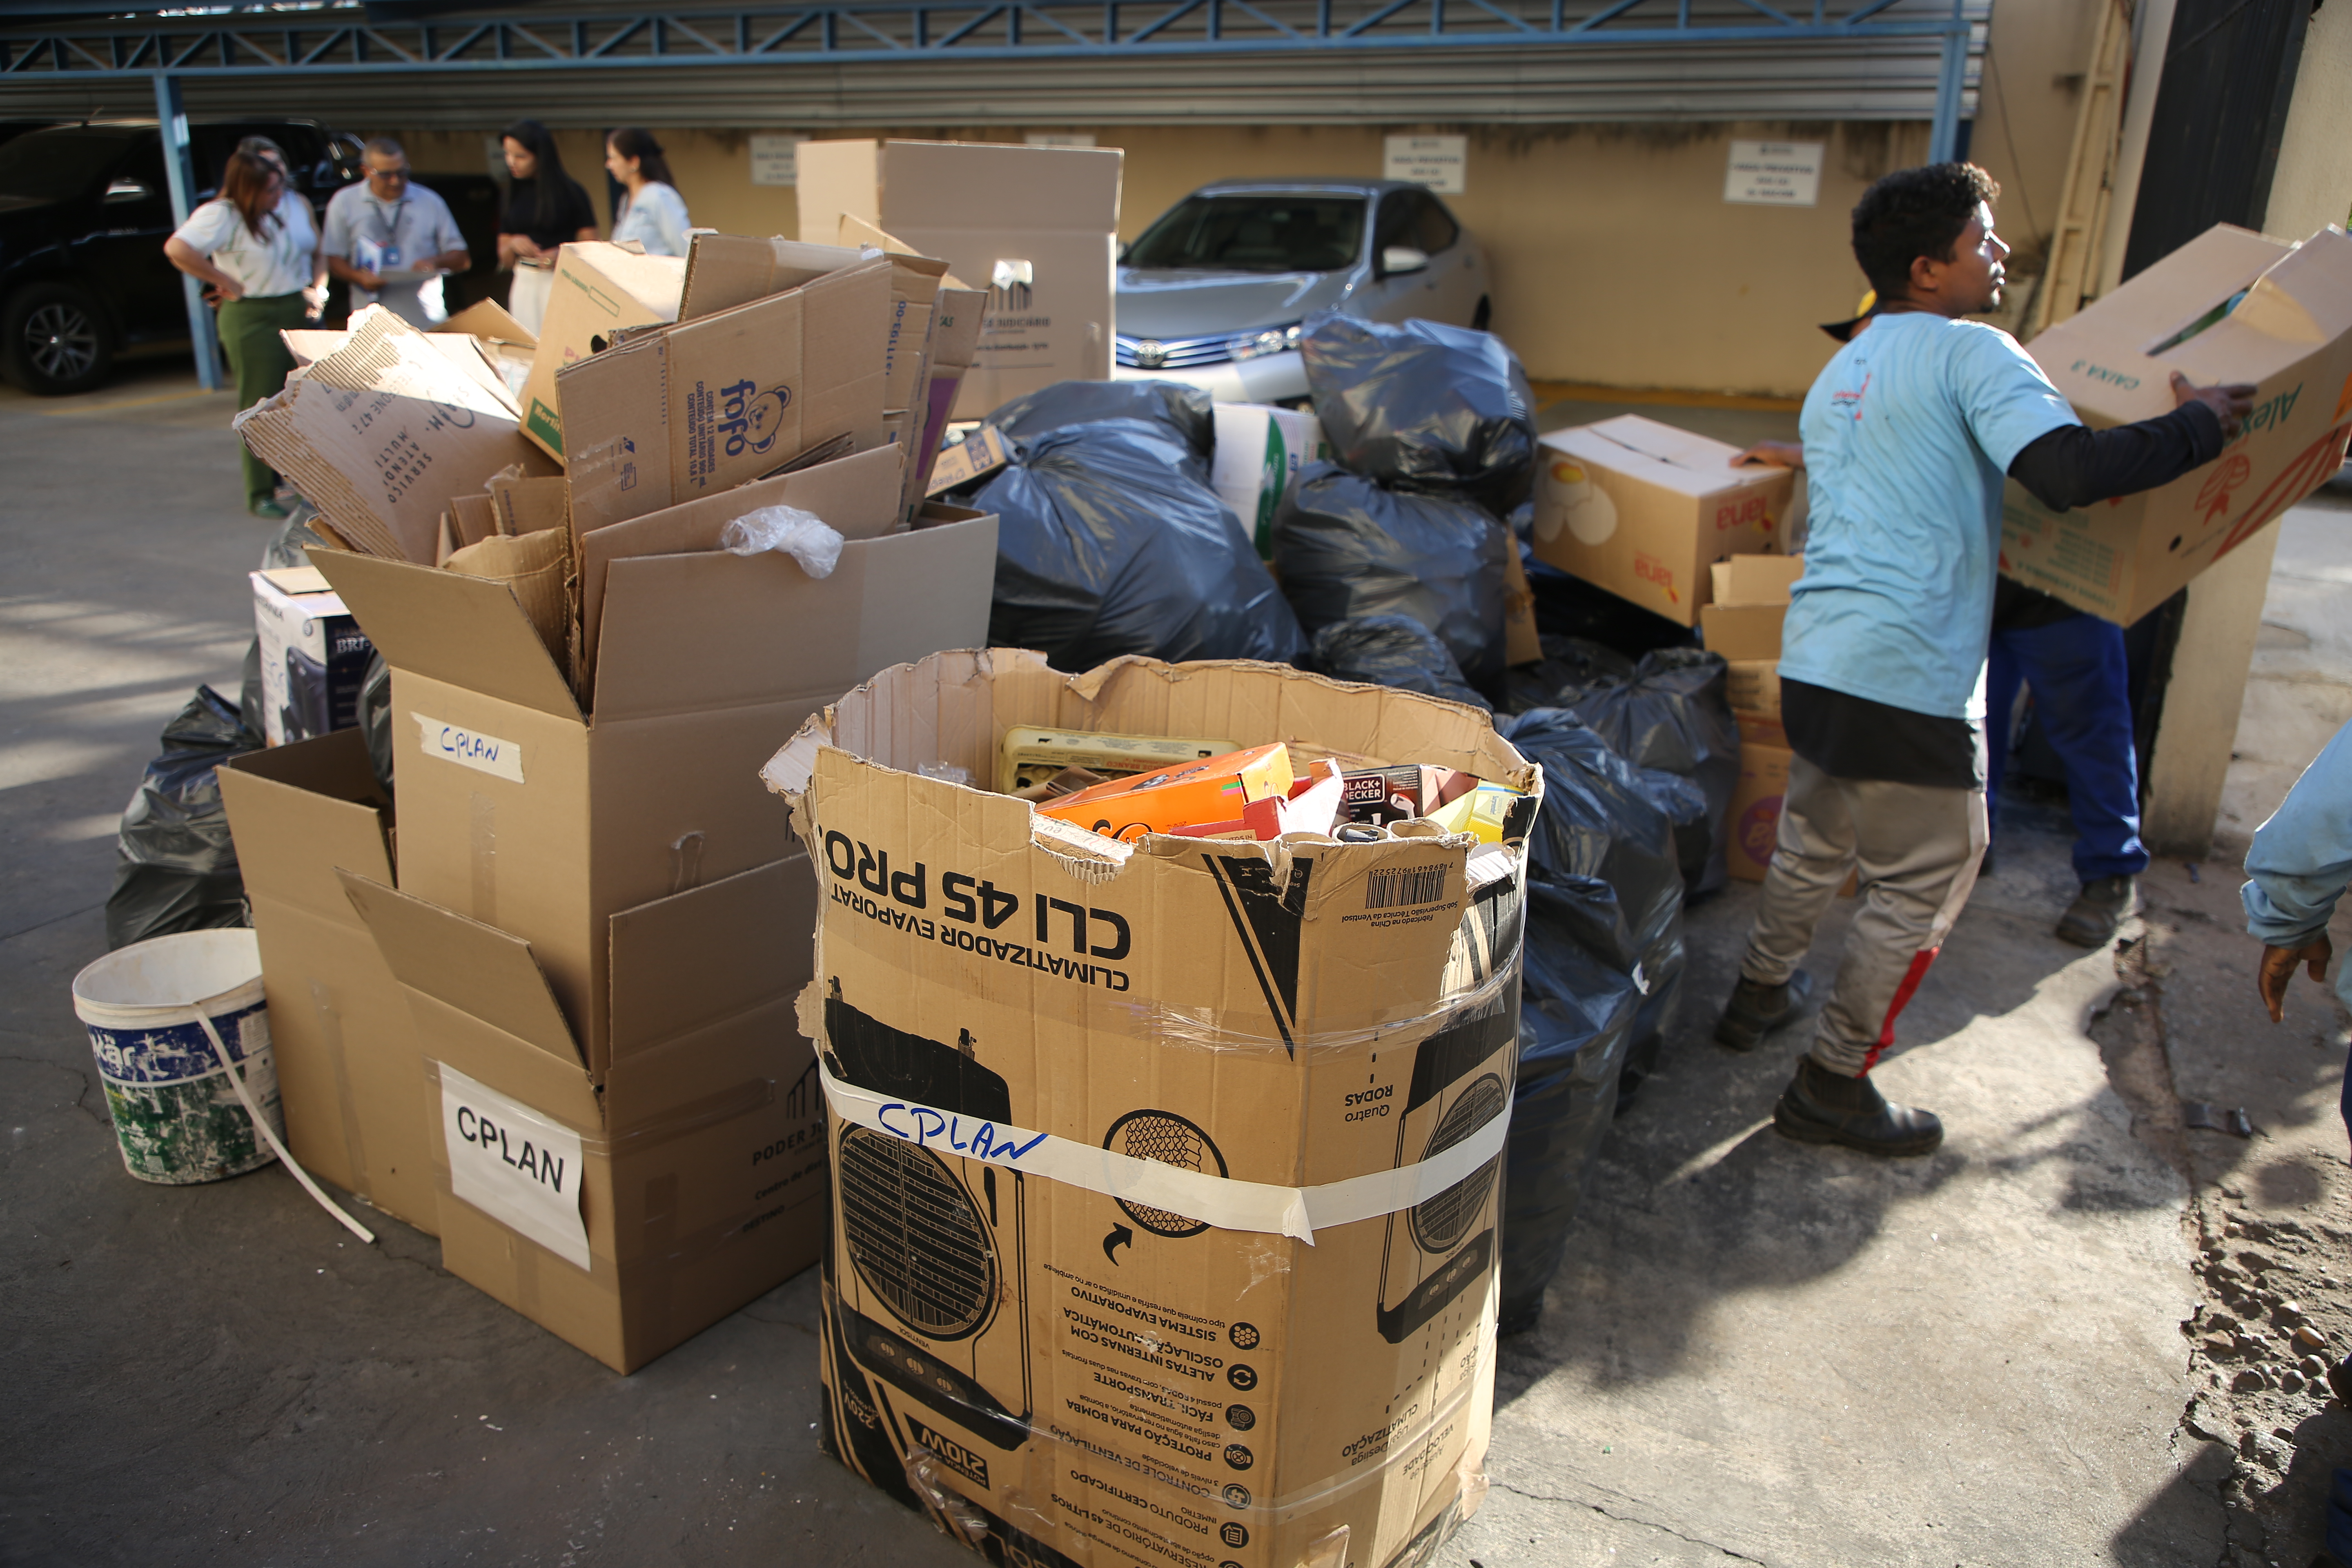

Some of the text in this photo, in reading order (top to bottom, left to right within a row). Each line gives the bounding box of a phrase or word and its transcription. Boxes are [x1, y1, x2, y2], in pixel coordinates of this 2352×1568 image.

[696, 381, 707, 422] CONTEÚDO
[360, 412, 374, 428] 47
[688, 393, 698, 434] CONTEÚDO
[718, 379, 756, 457] fofo
[707, 425, 715, 434] 12
[374, 431, 409, 468] MULTI
[689, 437, 698, 459] TOTAL
[698, 424, 707, 459] UNITÁRIO
[441, 727, 499, 762] CPLAN
[1344, 780, 1380, 791] BLACK+
[941, 871, 1019, 930] 45
[1411, 904, 1446, 915] Supervisão
[1447, 901, 1458, 910] Sob
[1342, 914, 1372, 923] Ventisol
[1383, 910, 1410, 919] Técnica
[1402, 914, 1433, 924] Fabricado
[1035, 892, 1131, 960] CLI
[940, 924, 1129, 992] CLIMATIZADOR
[1345, 1085, 1393, 1107] RODAS
[1345, 1105, 1390, 1122] Quatro
[878, 1103, 1049, 1160] CPLAN
[458, 1107, 564, 1193] CPLAN
[753, 1129, 806, 1166] PODER
[755, 1178, 789, 1200] Centro
[791, 1171, 802, 1183] de
[1075, 1276, 1084, 1285] no
[1099, 1285, 1131, 1300] umidifica
[1071, 1286, 1217, 1341] SISTEMA EVAPORATIVO
[1138, 1298, 1161, 1312] resfria
[1163, 1307, 1176, 1317] que
[1063, 1307, 1143, 1343] AUTOMÁTICA
[1178, 1312, 1207, 1325] colmeia
[1209, 1319, 1225, 1328] tipo
[897, 1325, 930, 1351] VENTISOL
[1062, 1350, 1088, 1365] frontais
[1071, 1325, 1215, 1382] ALETAS INTERNAS COM
[1089, 1360, 1105, 1372] duas
[1107, 1366, 1119, 1376] nas
[1120, 1371, 1142, 1384] travas
[1143, 1379, 1158, 1390] com
[1094, 1372, 1175, 1410] TRANSPORTE
[1080, 1394, 1104, 1409] bomba
[1196, 1399, 1222, 1409] possui
[843, 1392, 875, 1430] 220V
[1111, 1407, 1154, 1430] reservatório,
[1066, 1399, 1212, 1461] PROTEÇÃO PARA BOMBA
[1129, 1403, 1221, 1440] desliga automaticamente
[1155, 1423, 1165, 1432] no
[1342, 1403, 1418, 1457] CLIMATIZAÇÃO
[1166, 1426, 1183, 1441] água
[1184, 1434, 1200, 1445] falte
[920, 1427, 985, 1477] 210W
[1201, 1439, 1221, 1449] caso
[1049, 1424, 1211, 1499] CONTROLE DE VENTILAÇÃO
[1142, 1454, 1179, 1474] velocidade
[1180, 1468, 1189, 1478] de
[1190, 1473, 1212, 1486] níveis
[1050, 1493, 1089, 1519] LITROS
[1070, 1470, 1209, 1535] PRODUTO CERTIFICADO
[1090, 1513, 1103, 1524] 45
[1180, 1507, 1217, 1524] INMETRO
[1106, 1519, 1121, 1534] DE
[1102, 1509, 1215, 1563] opção de abastecimento contínuo
